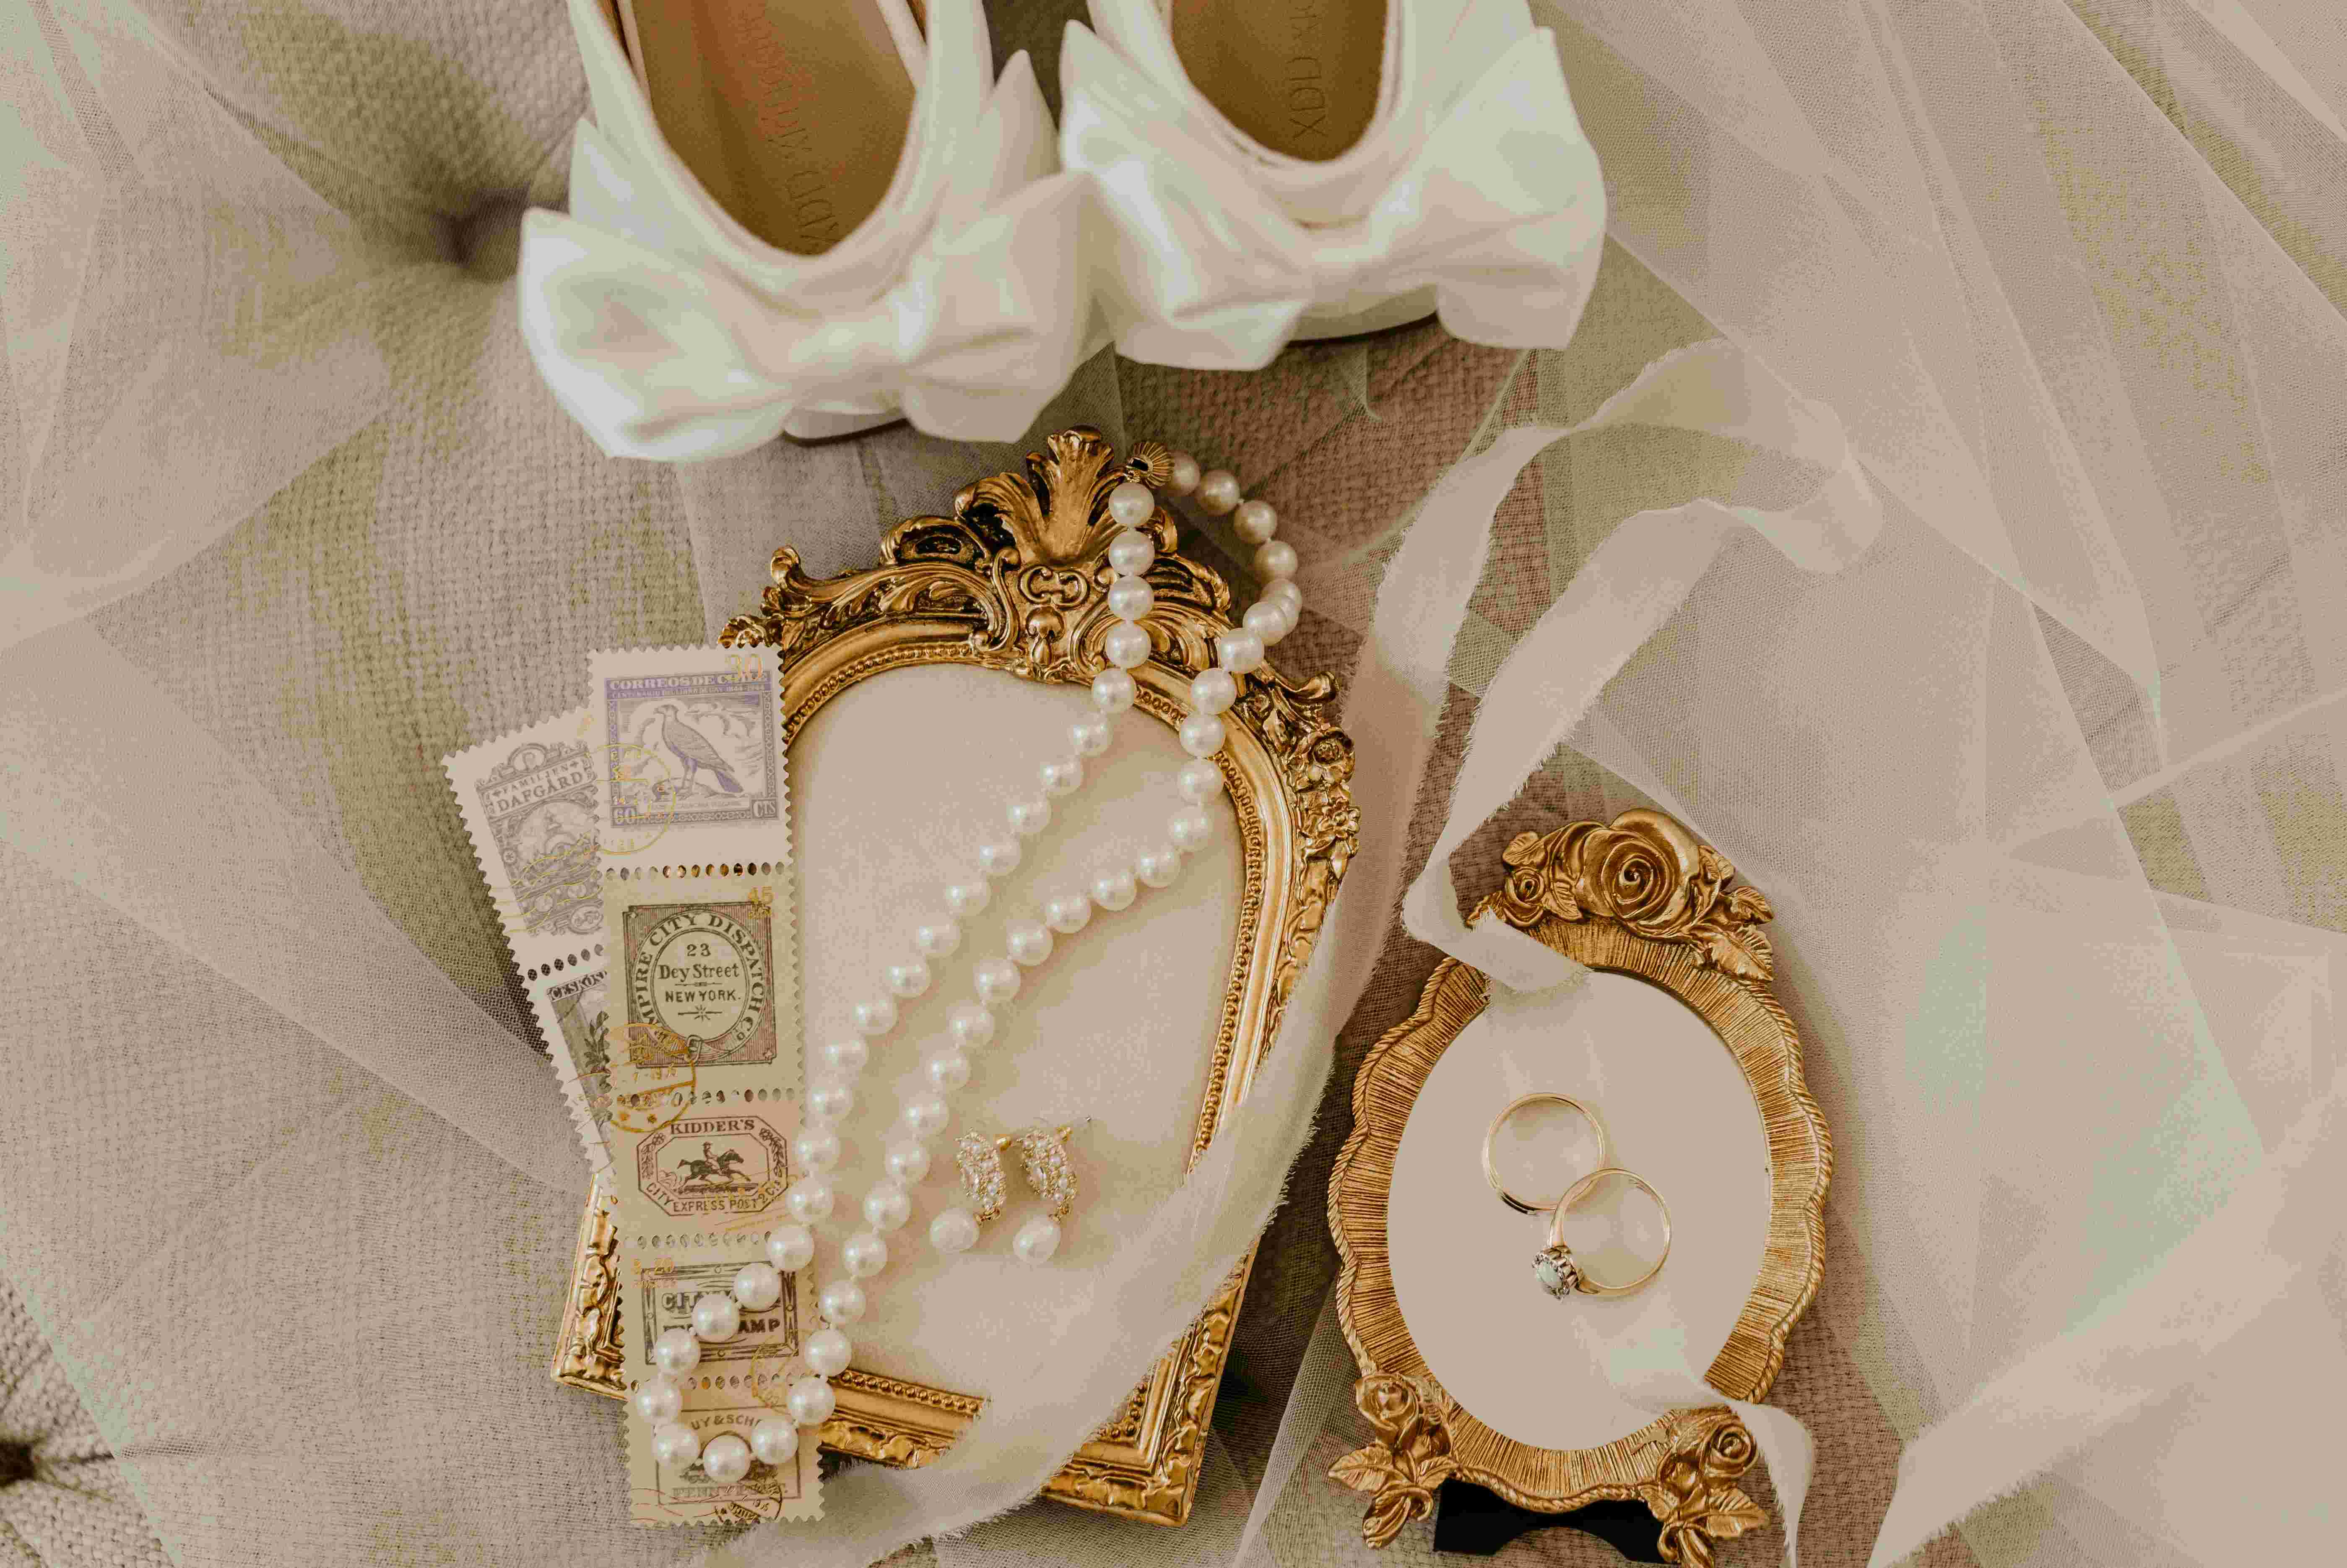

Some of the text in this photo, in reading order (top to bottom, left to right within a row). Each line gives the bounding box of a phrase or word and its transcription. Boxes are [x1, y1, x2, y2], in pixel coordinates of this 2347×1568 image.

[610, 676, 691, 690] CORREOS
[692, 675, 712, 686] DE
[497, 771, 582, 812] DAFGÅRD
[686, 944, 712, 957] 23
[649, 913, 699, 947] CITY
[708, 912, 764, 1016] DISPATCH
[658, 963, 740, 983] Dey Street
[665, 991, 696, 1003] NEW
[671, 1118, 755, 1136] KIDDER'S
[645, 1182, 673, 1206] CITY
[673, 1200, 725, 1212] EXPRESS
[730, 1198, 757, 1210] POST
[737, 1318, 780, 1334] AMP
[714, 1415, 724, 1425] &
[726, 1415, 762, 1427] SCH
